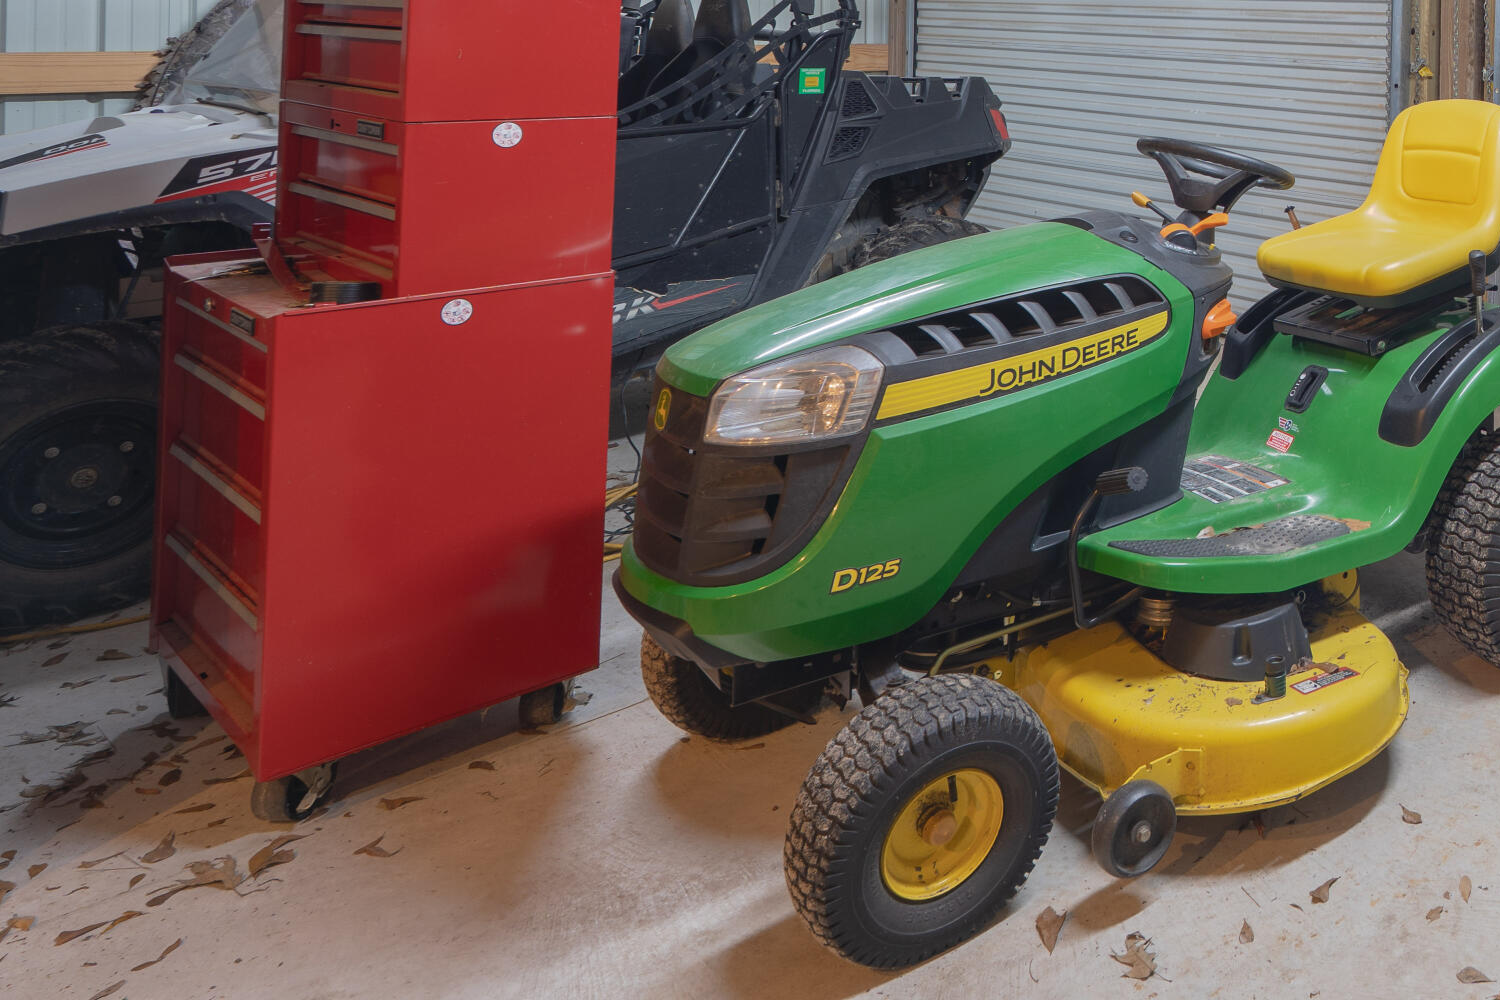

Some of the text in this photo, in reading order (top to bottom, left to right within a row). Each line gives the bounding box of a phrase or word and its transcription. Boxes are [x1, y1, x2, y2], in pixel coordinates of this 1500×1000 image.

[197, 150, 278, 184] 57
[980, 327, 1139, 394] JOHN DEERE
[830, 558, 902, 594] D125
